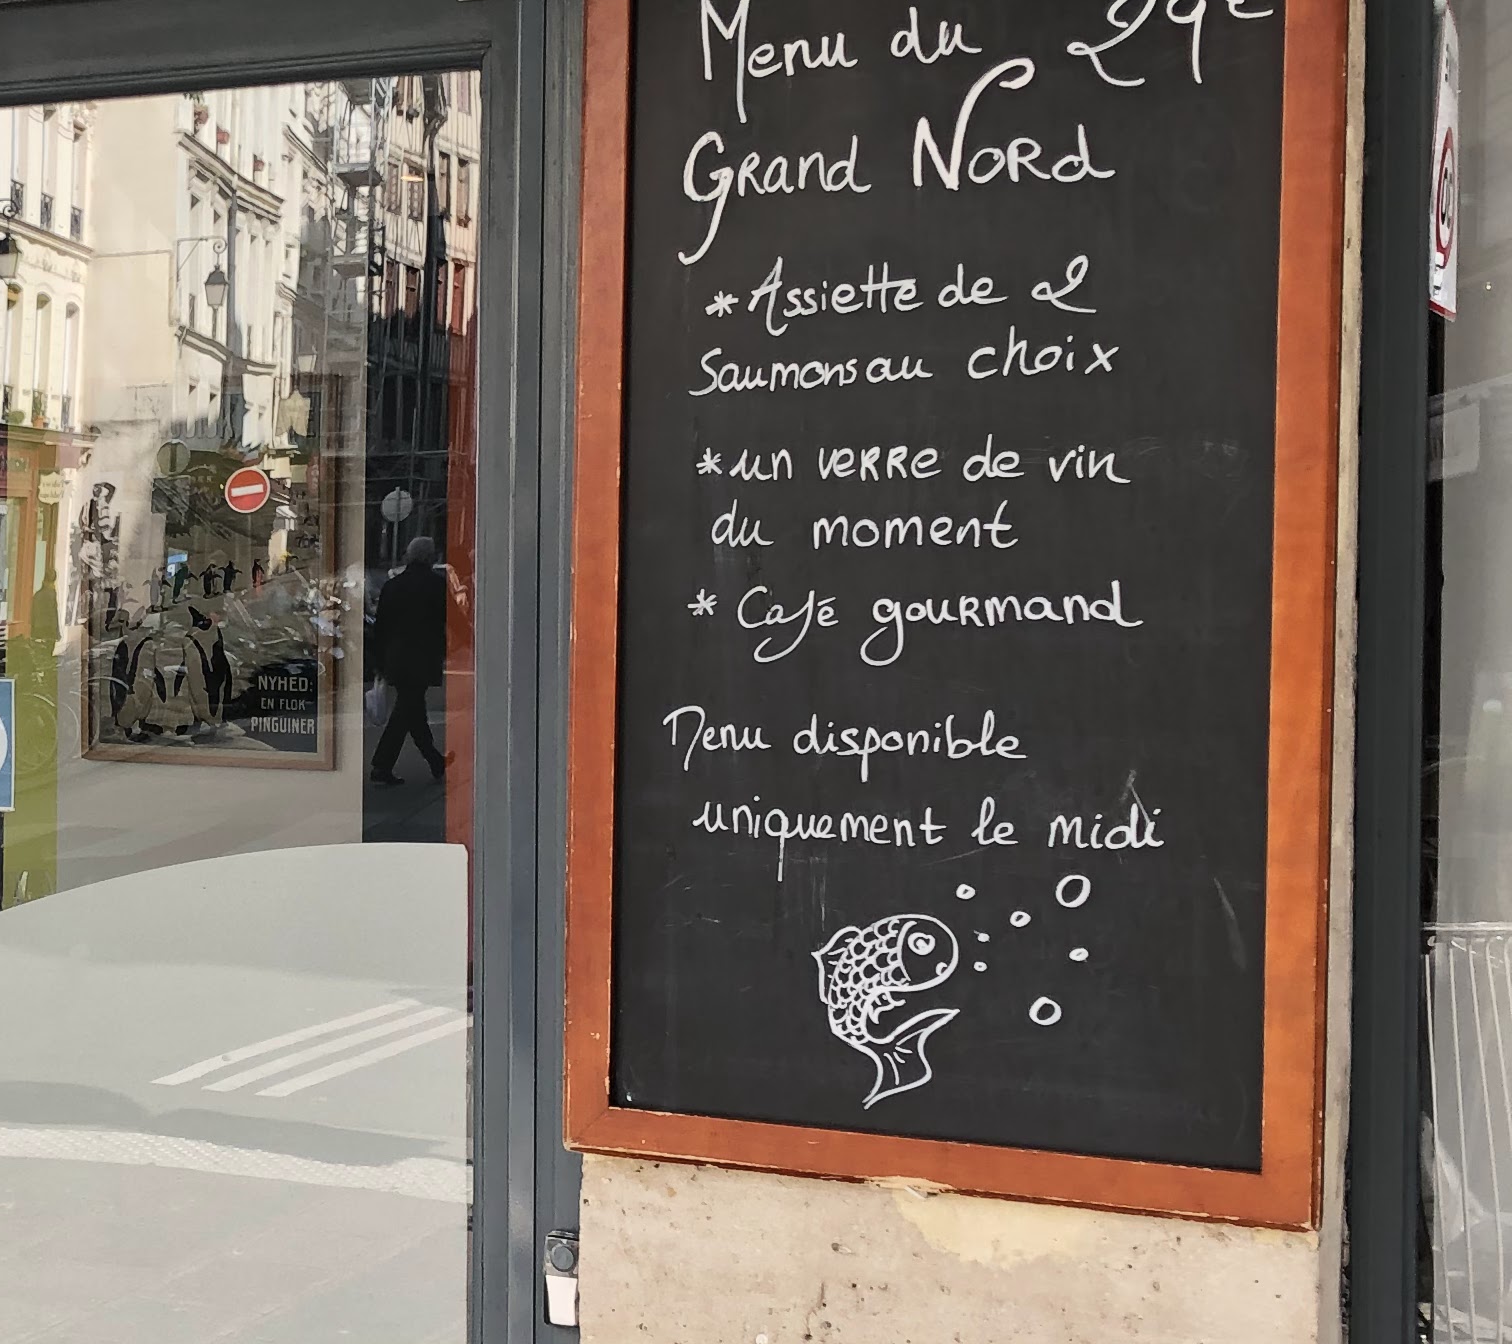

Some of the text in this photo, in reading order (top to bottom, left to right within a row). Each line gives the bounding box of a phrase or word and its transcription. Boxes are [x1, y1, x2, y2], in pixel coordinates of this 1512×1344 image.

[889, 7, 983, 64] du
[938, 263, 1008, 310] de
[1031, 255, 1097, 314] 2
[967, 326, 1121, 380] choix
[963, 434, 1026, 479] de
[1048, 444, 1132, 484] vin
[710, 499, 1019, 550] du moment
[792, 710, 1028, 783] disponible
[693, 794, 1166, 883] uniquement le midi
